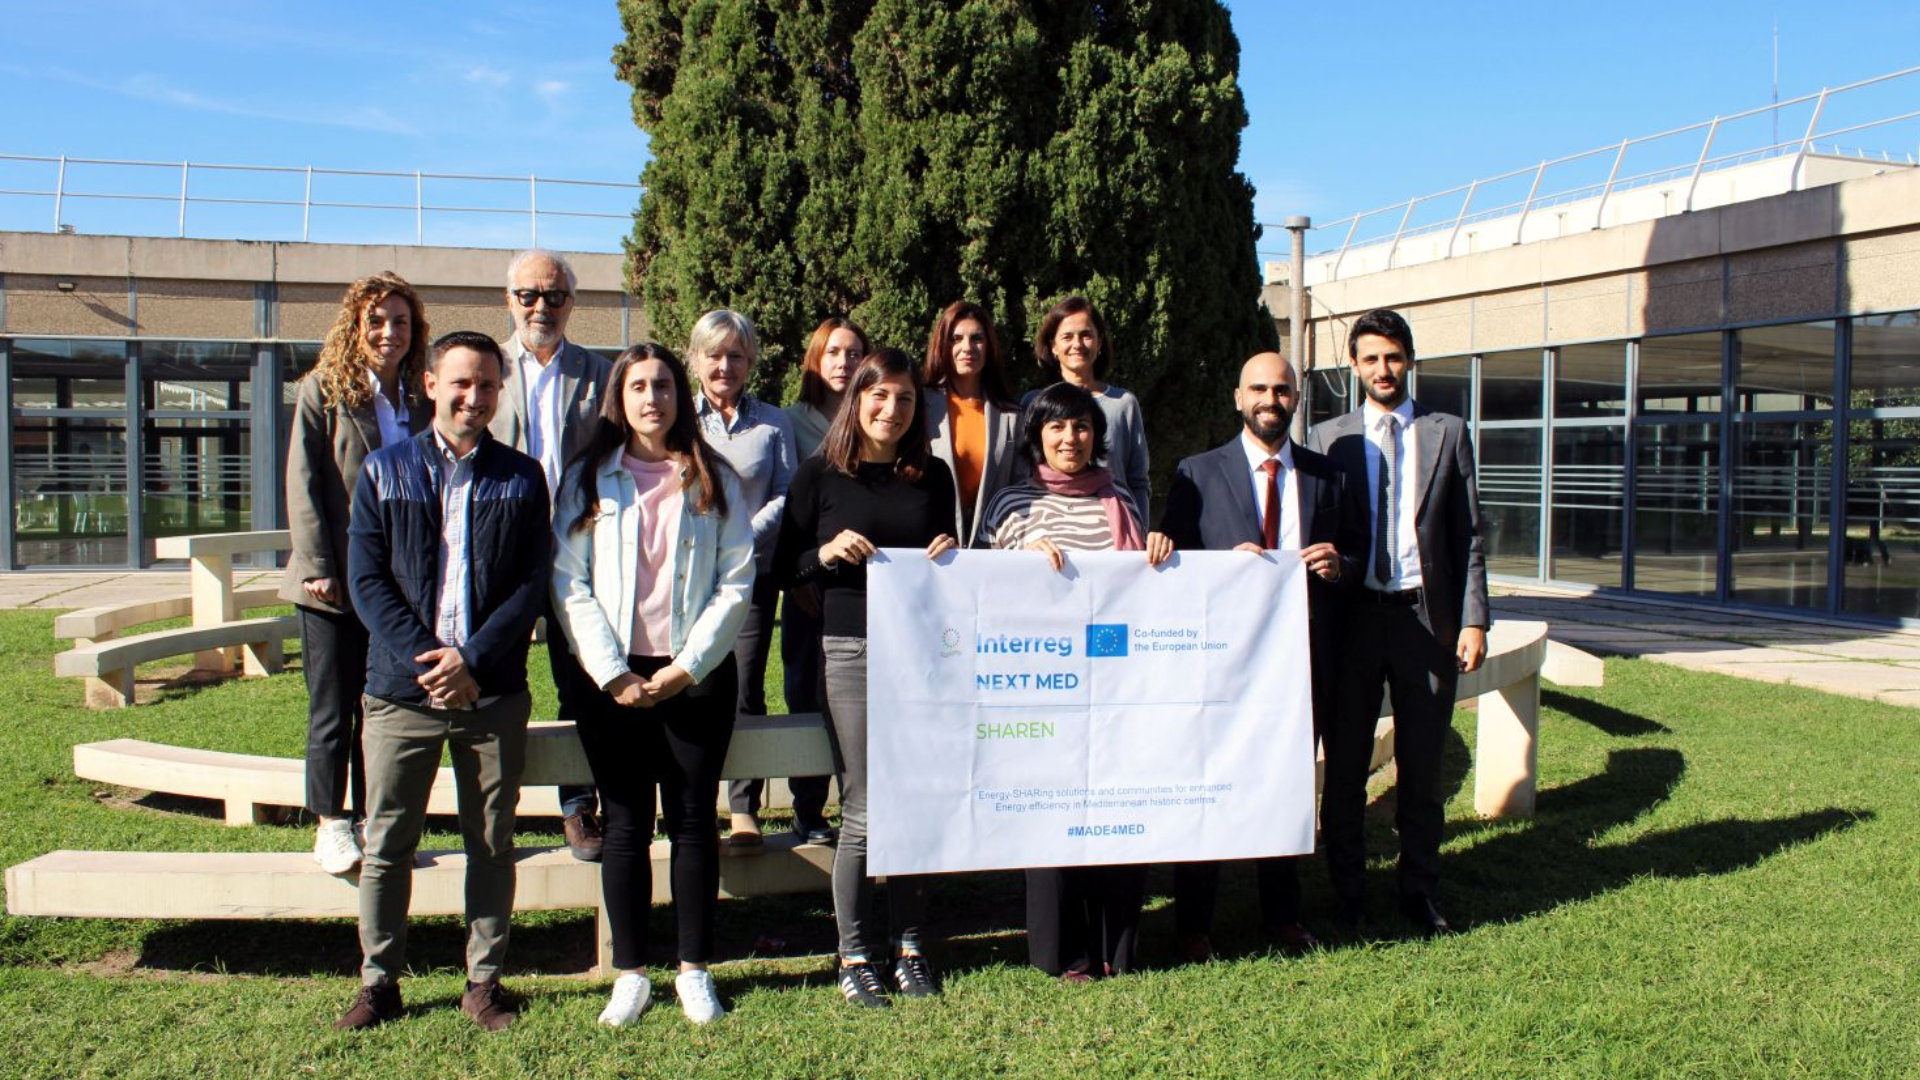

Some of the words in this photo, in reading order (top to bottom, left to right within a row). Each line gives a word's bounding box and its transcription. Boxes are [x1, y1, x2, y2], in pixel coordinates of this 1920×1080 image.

[1134, 628, 1184, 638] Co-funded
[1187, 628, 1198, 641] by
[976, 632, 1073, 657] Interreg
[1134, 642, 1150, 651] the
[1153, 642, 1198, 653] European
[1201, 641, 1228, 650] Union
[977, 674, 1030, 690] NEXT
[1036, 673, 1079, 689] MED
[976, 721, 1055, 740] SHAREN
[978, 789, 1010, 801] Energy
[1012, 788, 1053, 799] SHARing
[1056, 787, 1095, 797] solutions
[1098, 786, 1115, 795] and
[1118, 784, 1173, 795] communities
[1175, 784, 1187, 793] for
[995, 801, 1027, 813] Energy
[1029, 801, 1070, 811] efficiency
[1073, 800, 1081, 809] in
[1083, 799, 1147, 809] Mediterranean
[1149, 797, 1181, 806] historic
[1067, 824, 1146, 837] #MADE4MED
